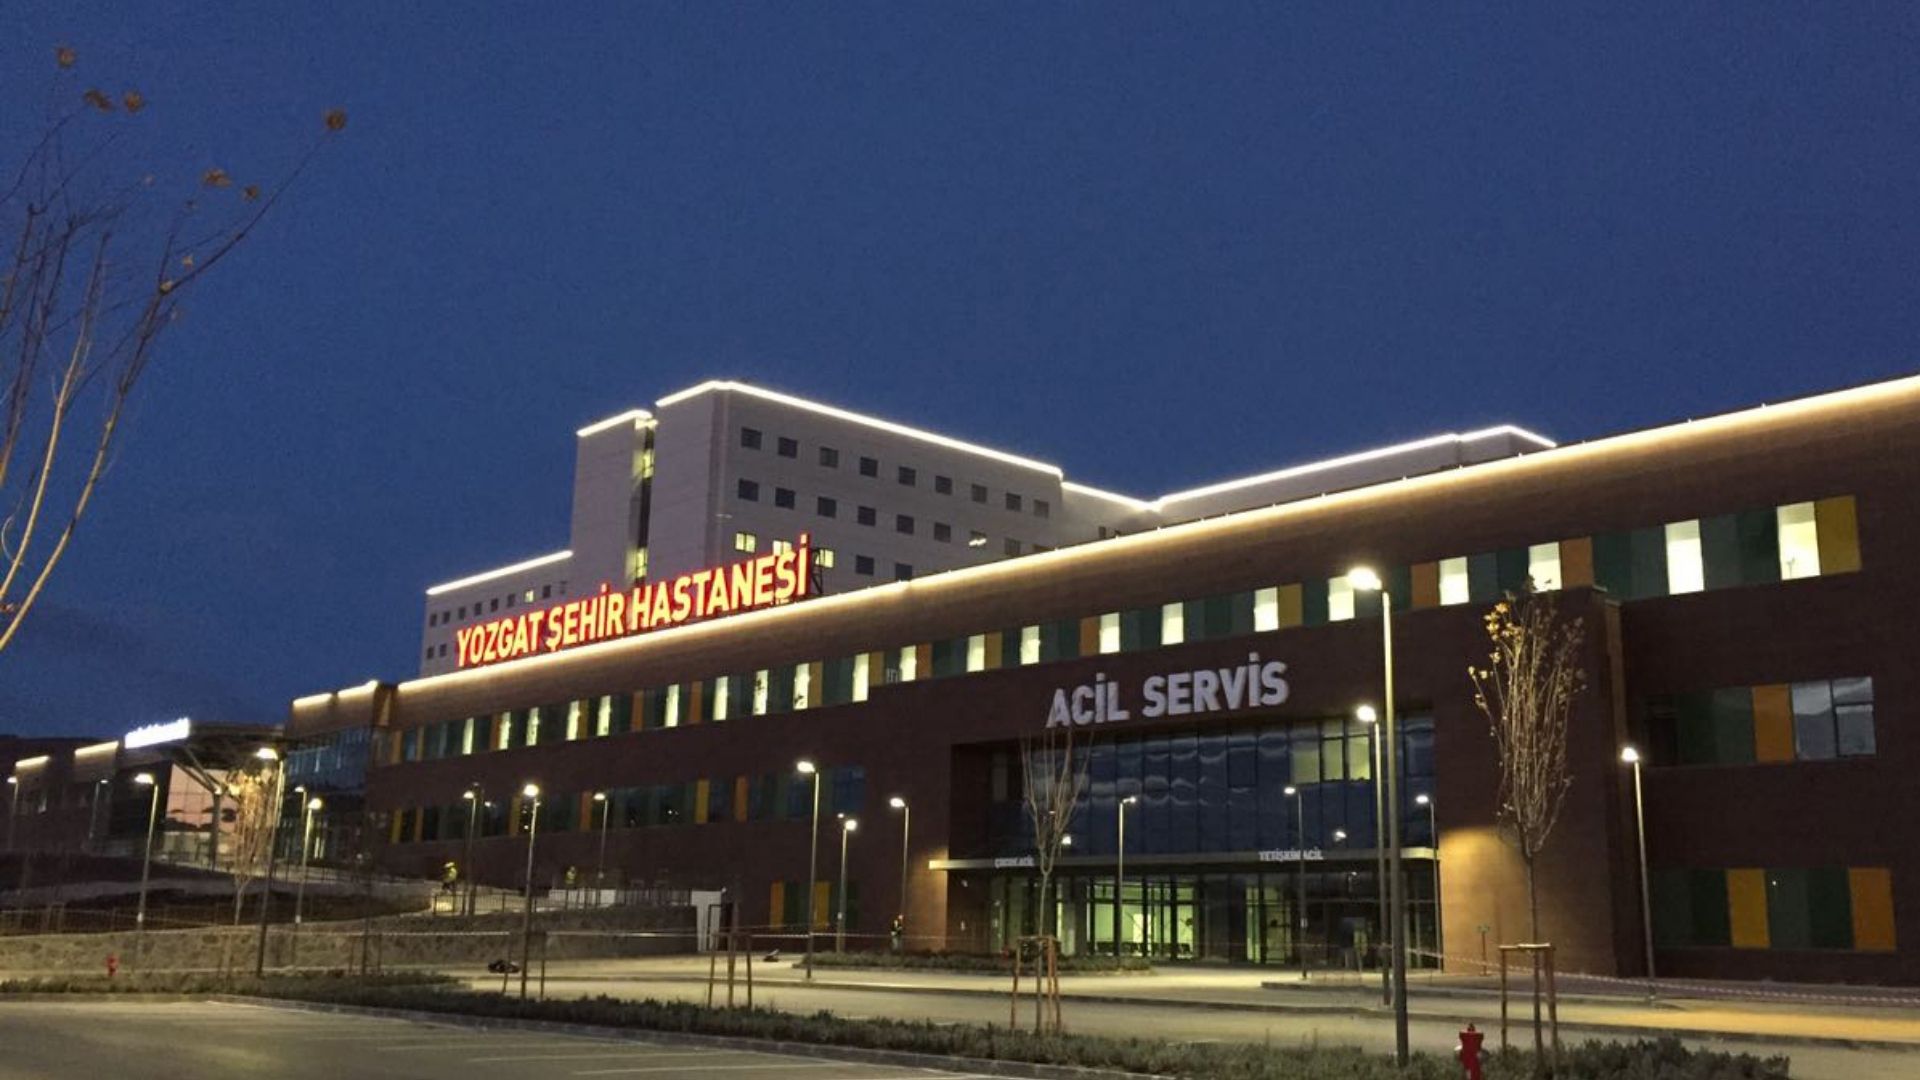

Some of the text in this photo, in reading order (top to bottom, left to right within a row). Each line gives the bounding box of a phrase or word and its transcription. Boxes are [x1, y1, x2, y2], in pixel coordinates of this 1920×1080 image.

[456, 533, 812, 666] YOZGAT ŞEHİR HASTANESİ
[1045, 652, 1289, 729] ACİL SERVİS
